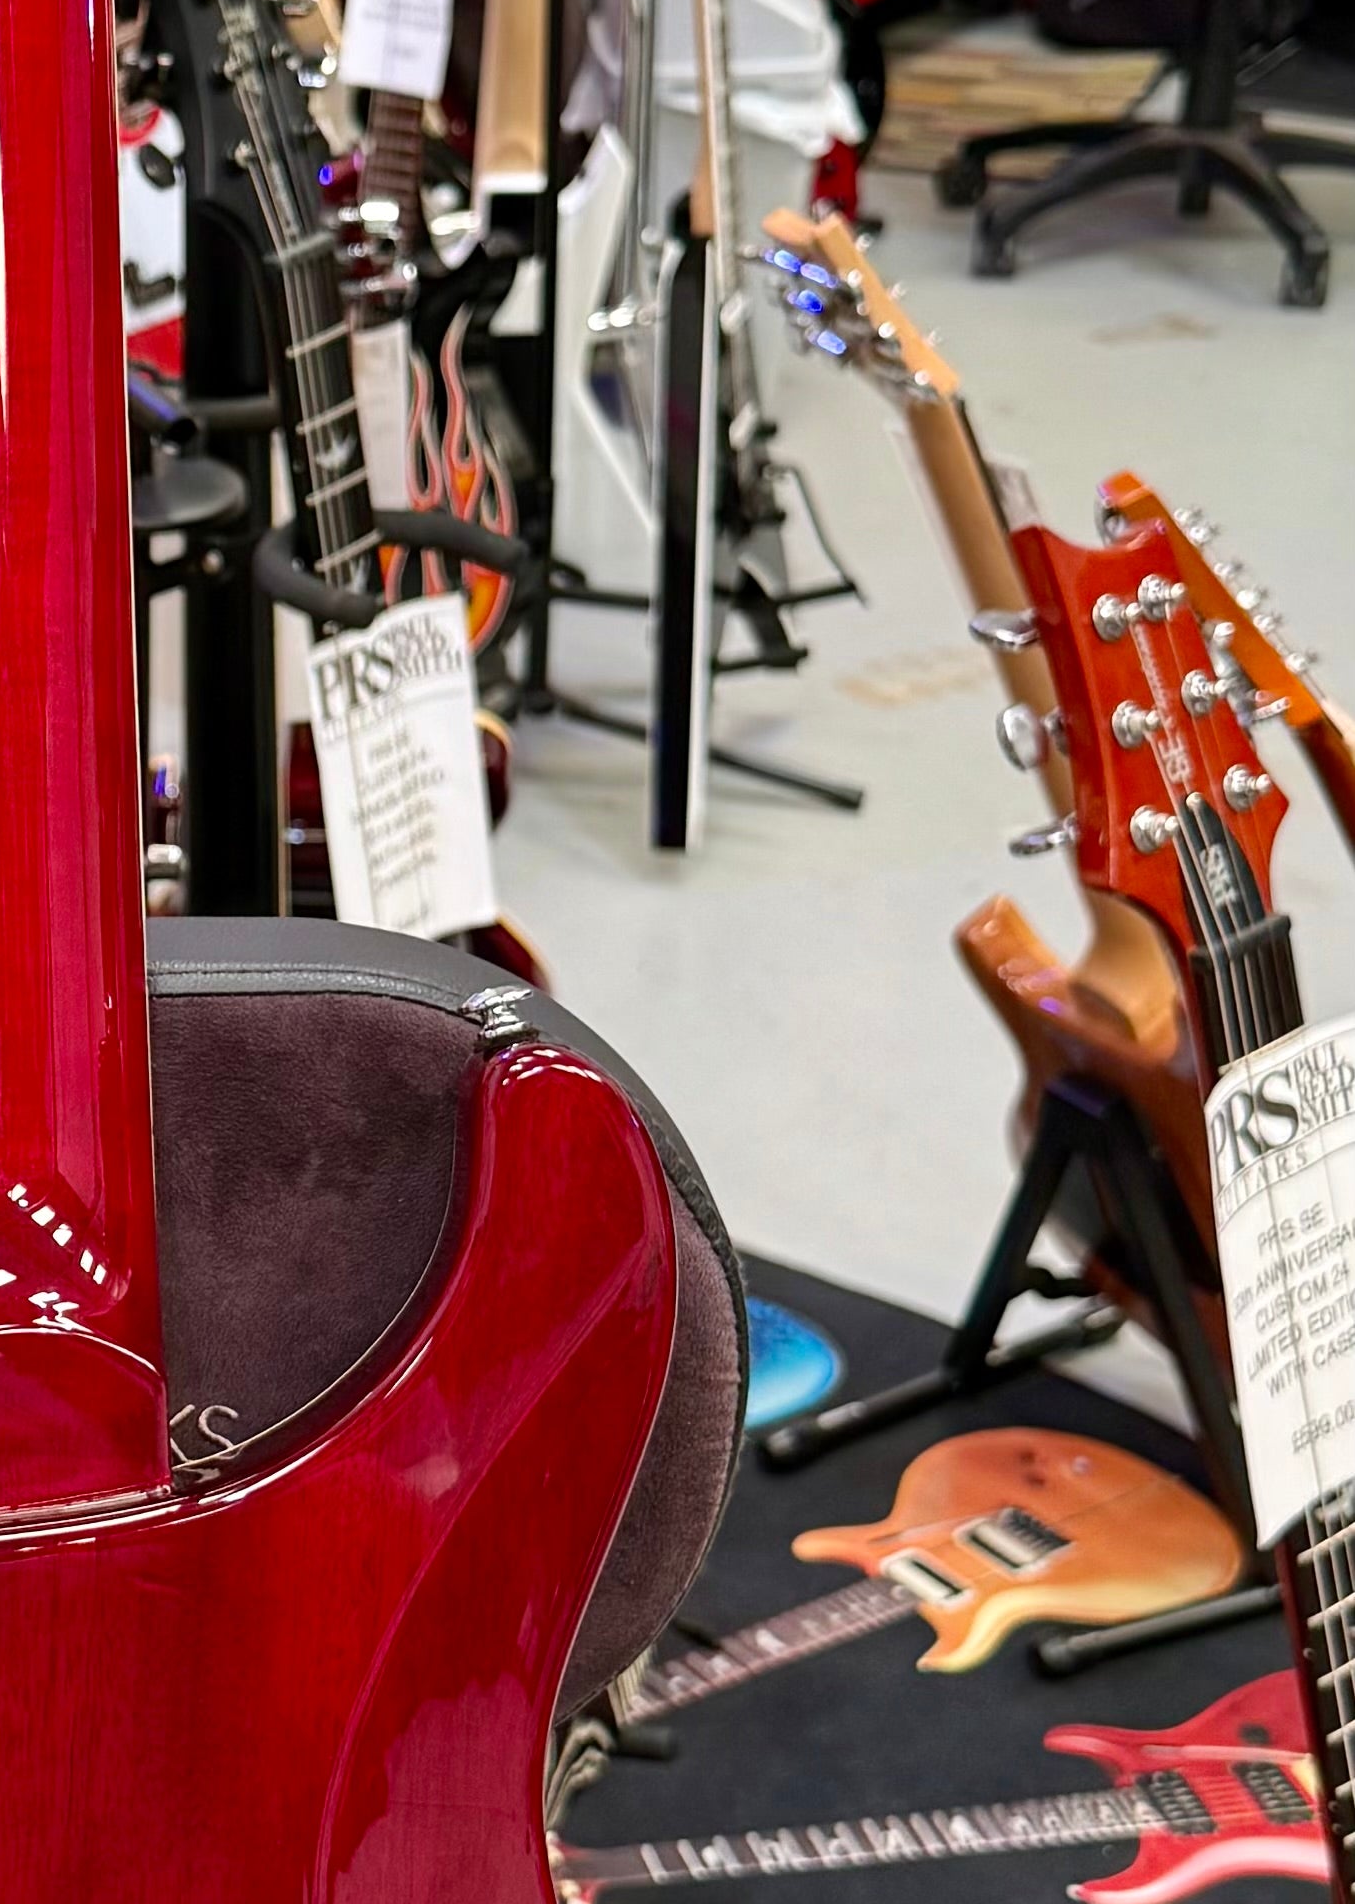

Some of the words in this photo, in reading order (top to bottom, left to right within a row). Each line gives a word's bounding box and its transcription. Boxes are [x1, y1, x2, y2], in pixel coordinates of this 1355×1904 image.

[313, 632, 396, 722] PRS
[1293, 1040, 1341, 1077] PAUL
[1211, 1064, 1300, 1192] PRS
[1256, 1218, 1295, 1257] PRS
[1298, 1201, 1326, 1233] SE
[1254, 1270, 1329, 1334] CUSTOM
[1331, 1257, 1351, 1287] 24
[1247, 1322, 1303, 1382] LIMITED
[1265, 1354, 1309, 1399] WITH
